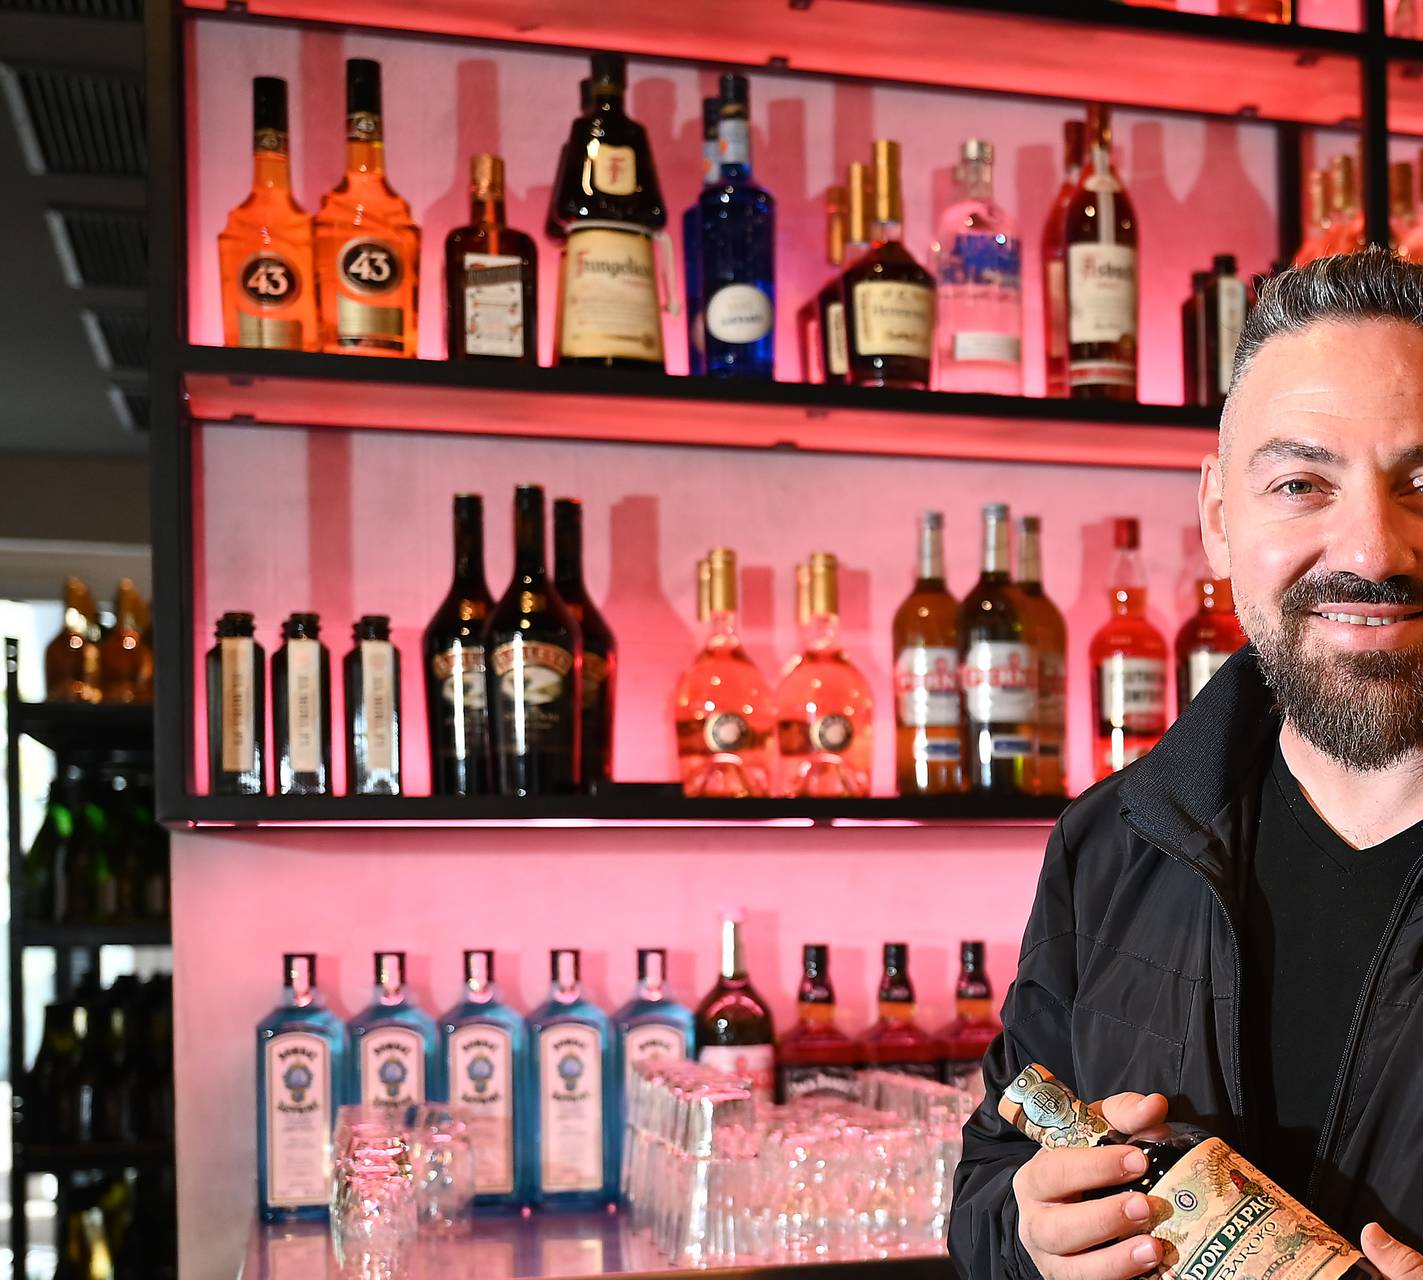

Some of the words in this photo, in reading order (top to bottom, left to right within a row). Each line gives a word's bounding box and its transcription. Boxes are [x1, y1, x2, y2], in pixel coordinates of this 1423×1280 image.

[247, 266, 289, 296] 43
[349, 250, 391, 282] 43
[1190, 1237, 1227, 1280] DON
[1221, 1200, 1266, 1242] PAPA
[1218, 1220, 1280, 1280] BAROKO
